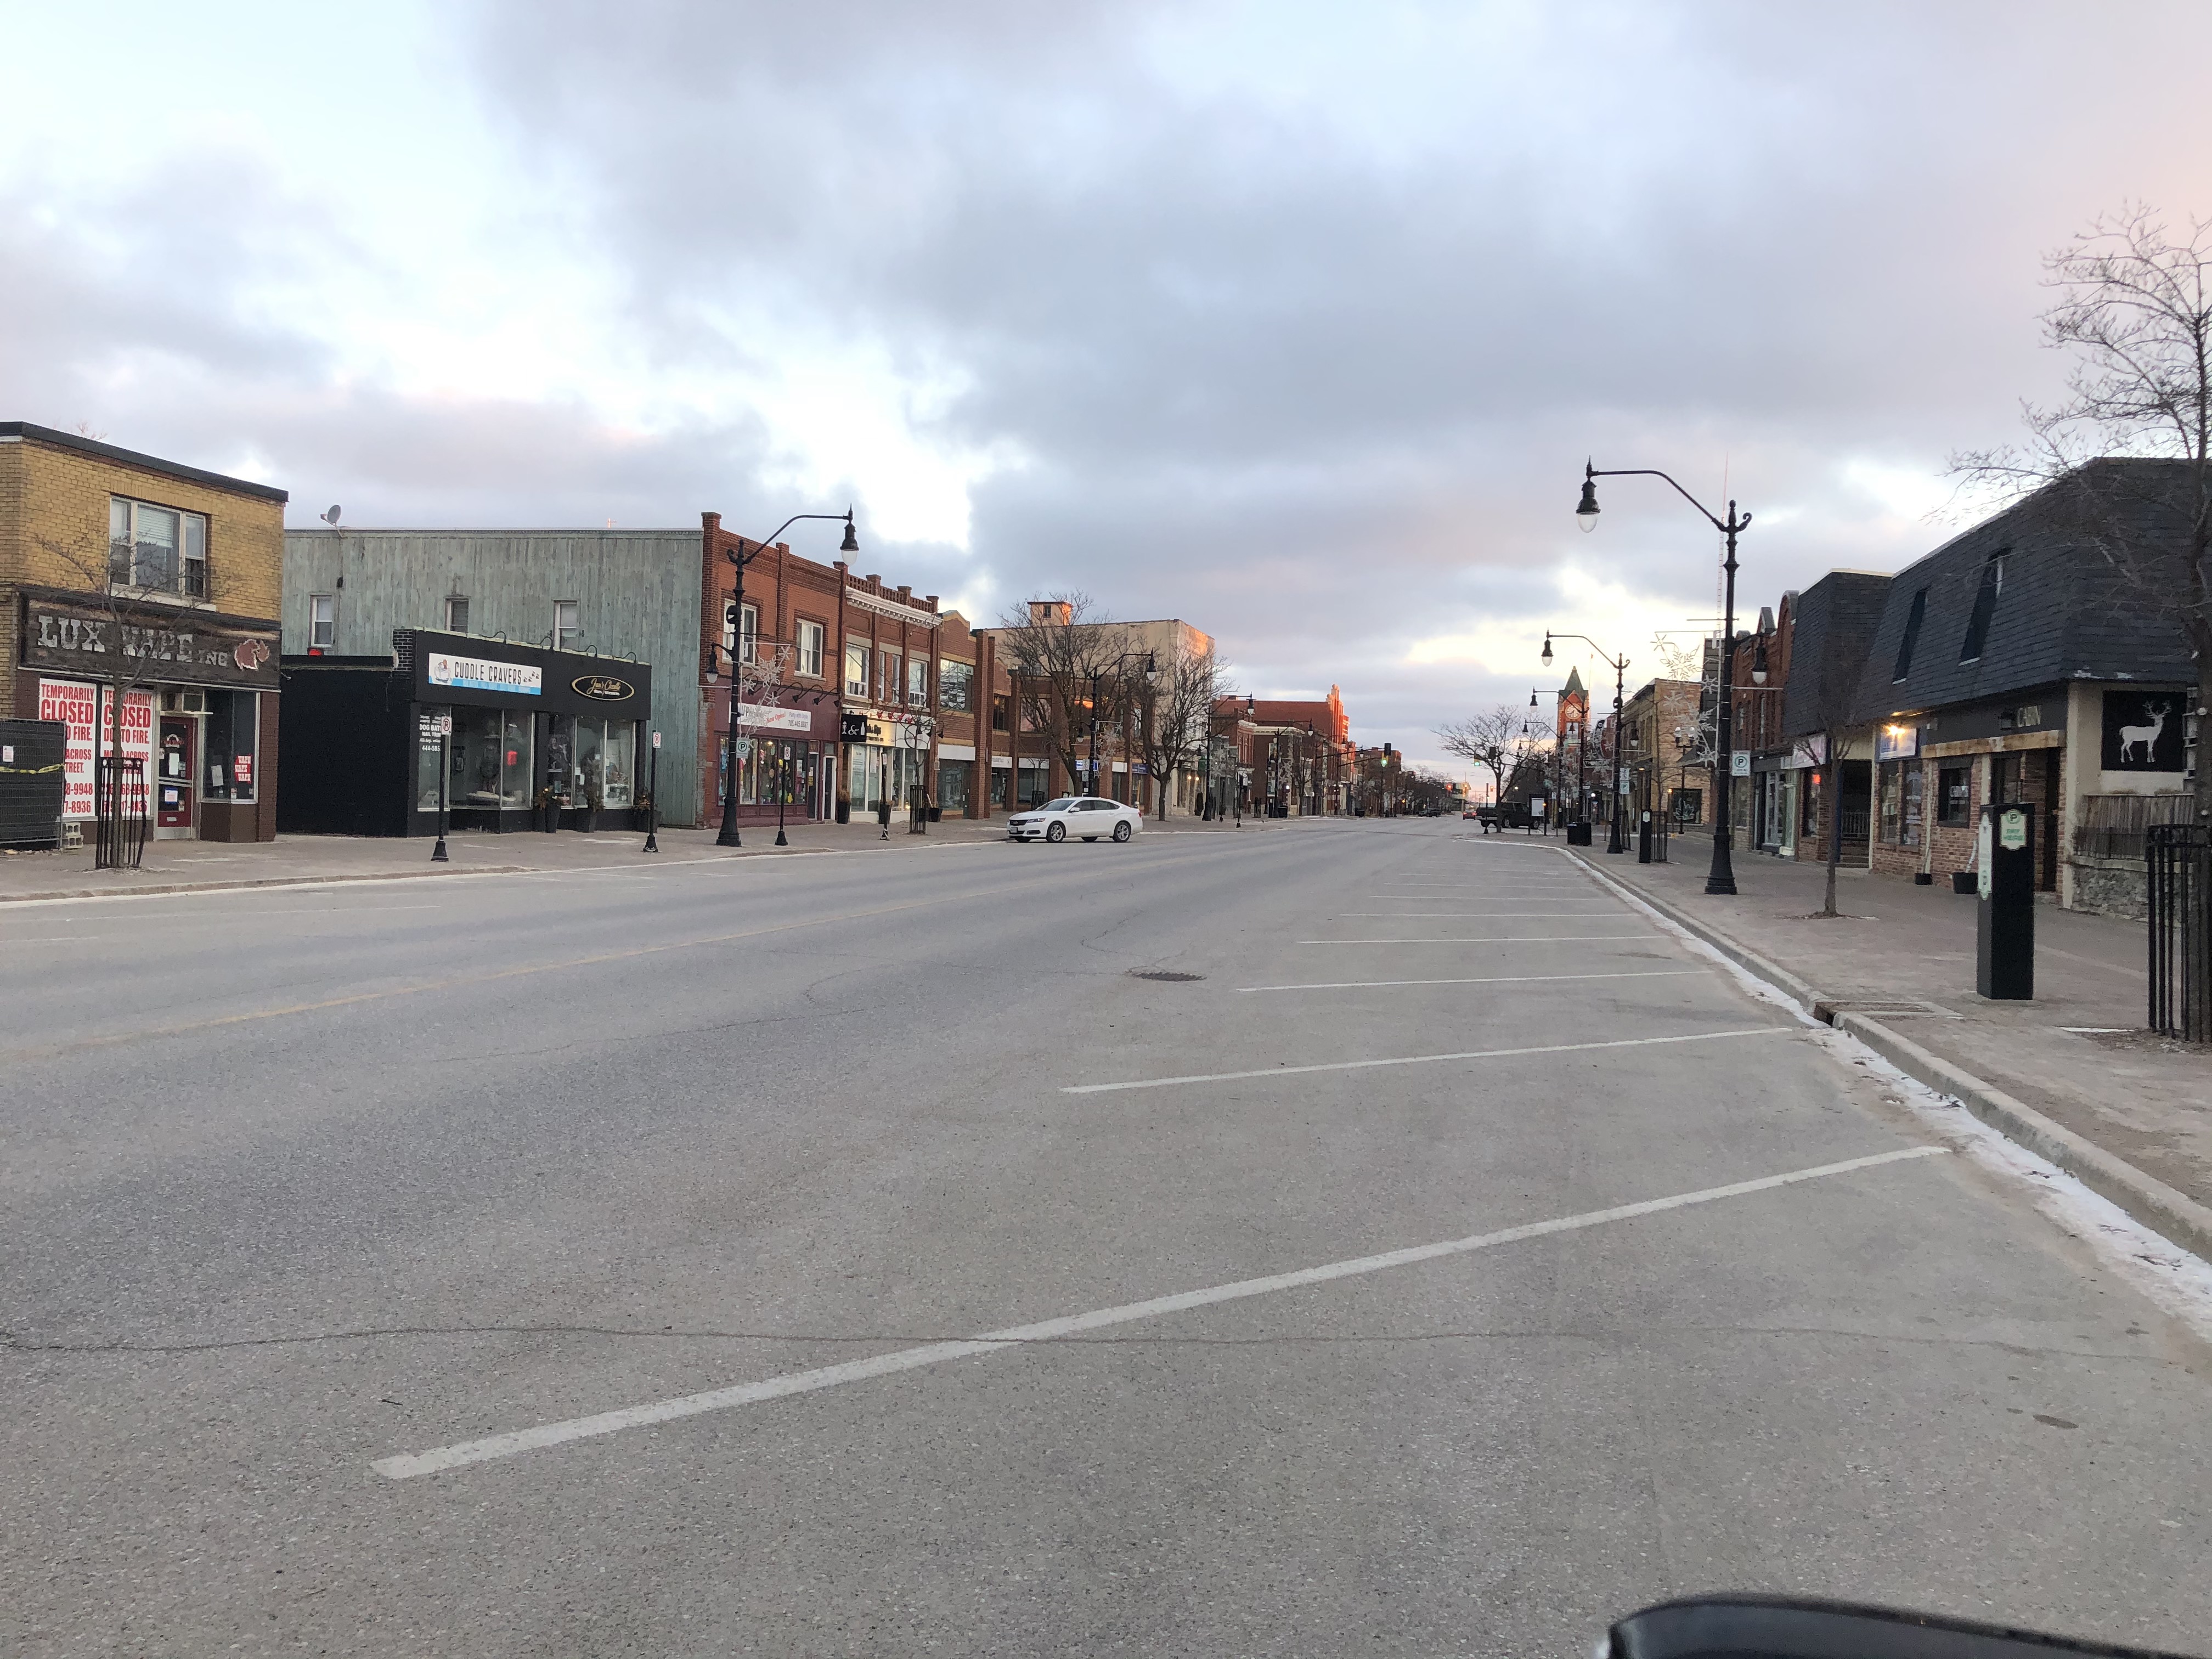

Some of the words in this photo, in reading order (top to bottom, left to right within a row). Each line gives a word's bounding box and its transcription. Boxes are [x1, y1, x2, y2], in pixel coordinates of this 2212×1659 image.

[38, 615, 105, 652] LUX
[198, 650, 227, 666] INC
[455, 661, 484, 680] CUDDLE
[489, 665, 522, 685] CRAVERS
[41, 684, 95, 701] TEMPORARILY
[104, 690, 152, 707] TEORARILY
[41, 699, 94, 724] CLOSED
[104, 704, 151, 727] COSED
[74, 726, 93, 741] FIRE.
[104, 727, 113, 742] DU
[133, 730, 150, 744] FIRE.
[65, 748, 92, 760] ACROSS
[65, 762, 84, 773] TREET.
